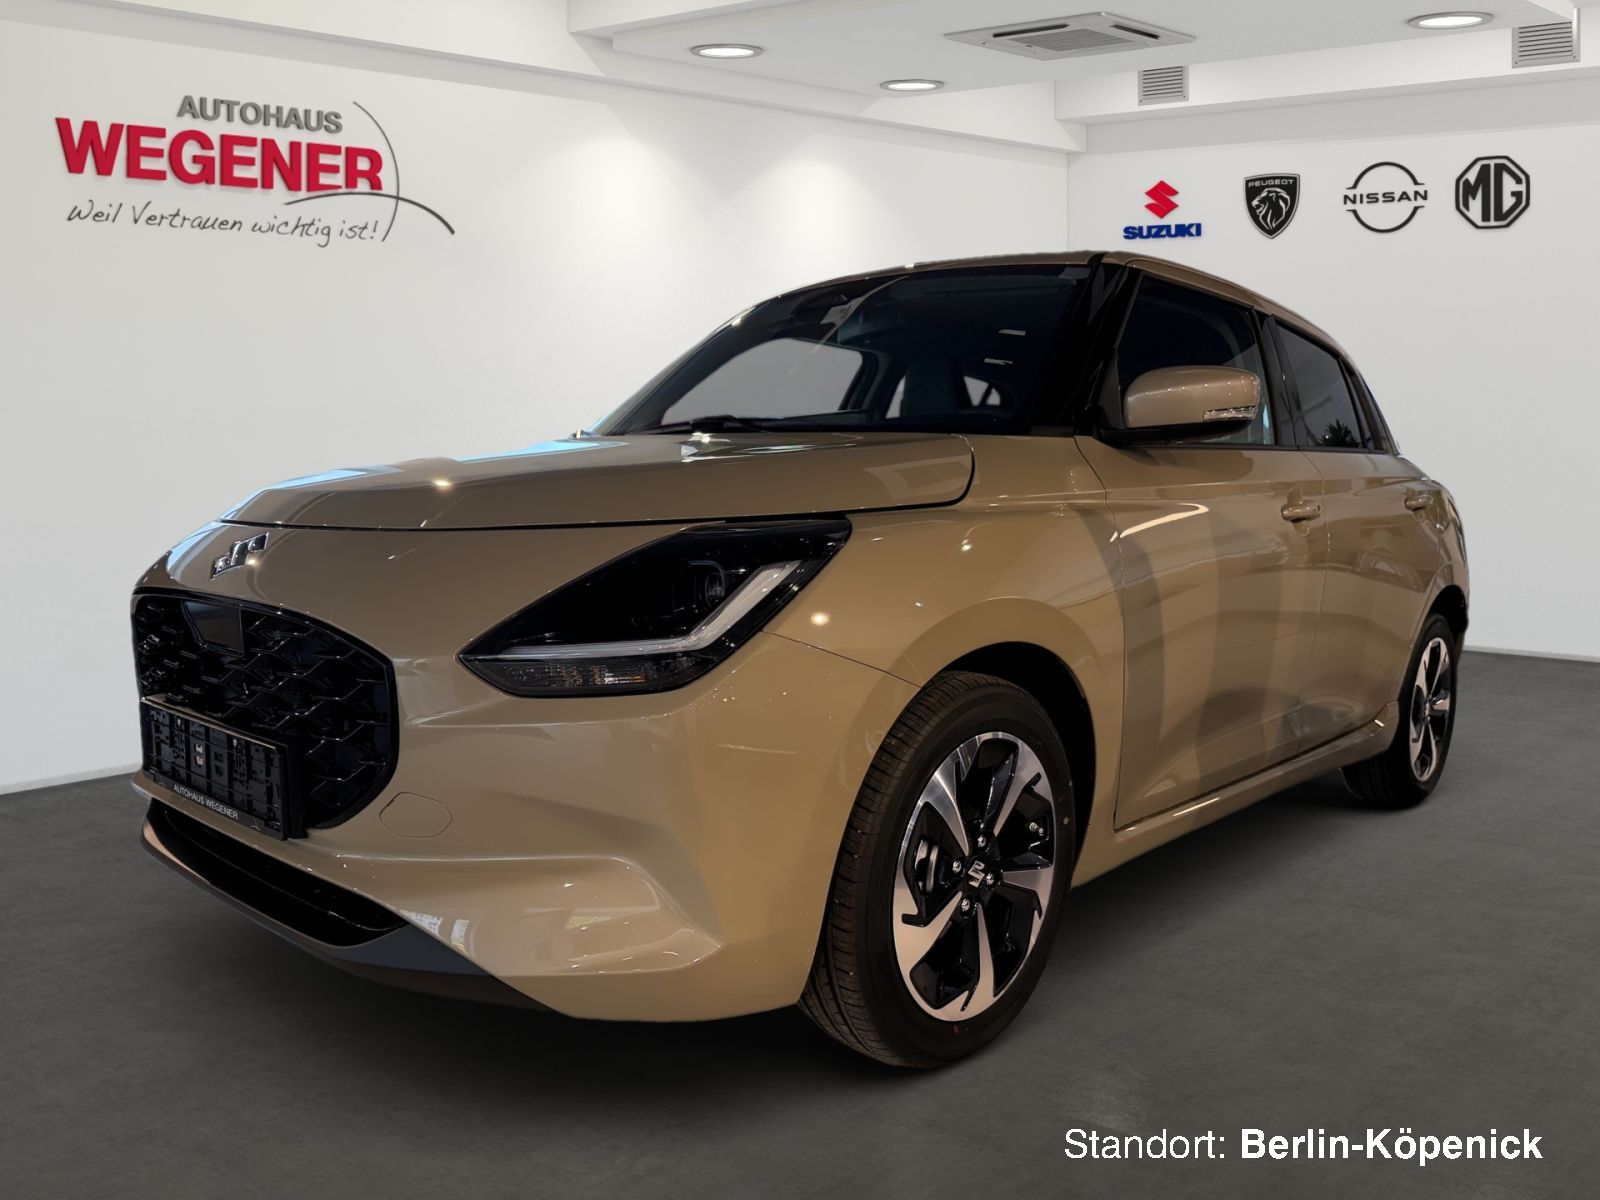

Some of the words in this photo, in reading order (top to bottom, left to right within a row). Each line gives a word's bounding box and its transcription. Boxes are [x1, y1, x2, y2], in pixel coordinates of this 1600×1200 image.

[177, 95, 343, 133] AUTOHAUS
[55, 117, 383, 193] WEGENER
[1248, 179, 1294, 187] PEUGEOT
[1343, 190, 1428, 205] NISSAN
[1462, 162, 1524, 222] MG
[67, 199, 123, 223] Weil
[132, 201, 242, 232] Vertrauen
[251, 212, 332, 248] wichtig
[338, 220, 379, 240] ist!
[1123, 222, 1202, 240] SUZUKI
[173, 784, 204, 804] AUTOHAUS
[205, 799, 239, 820] WEGENER
